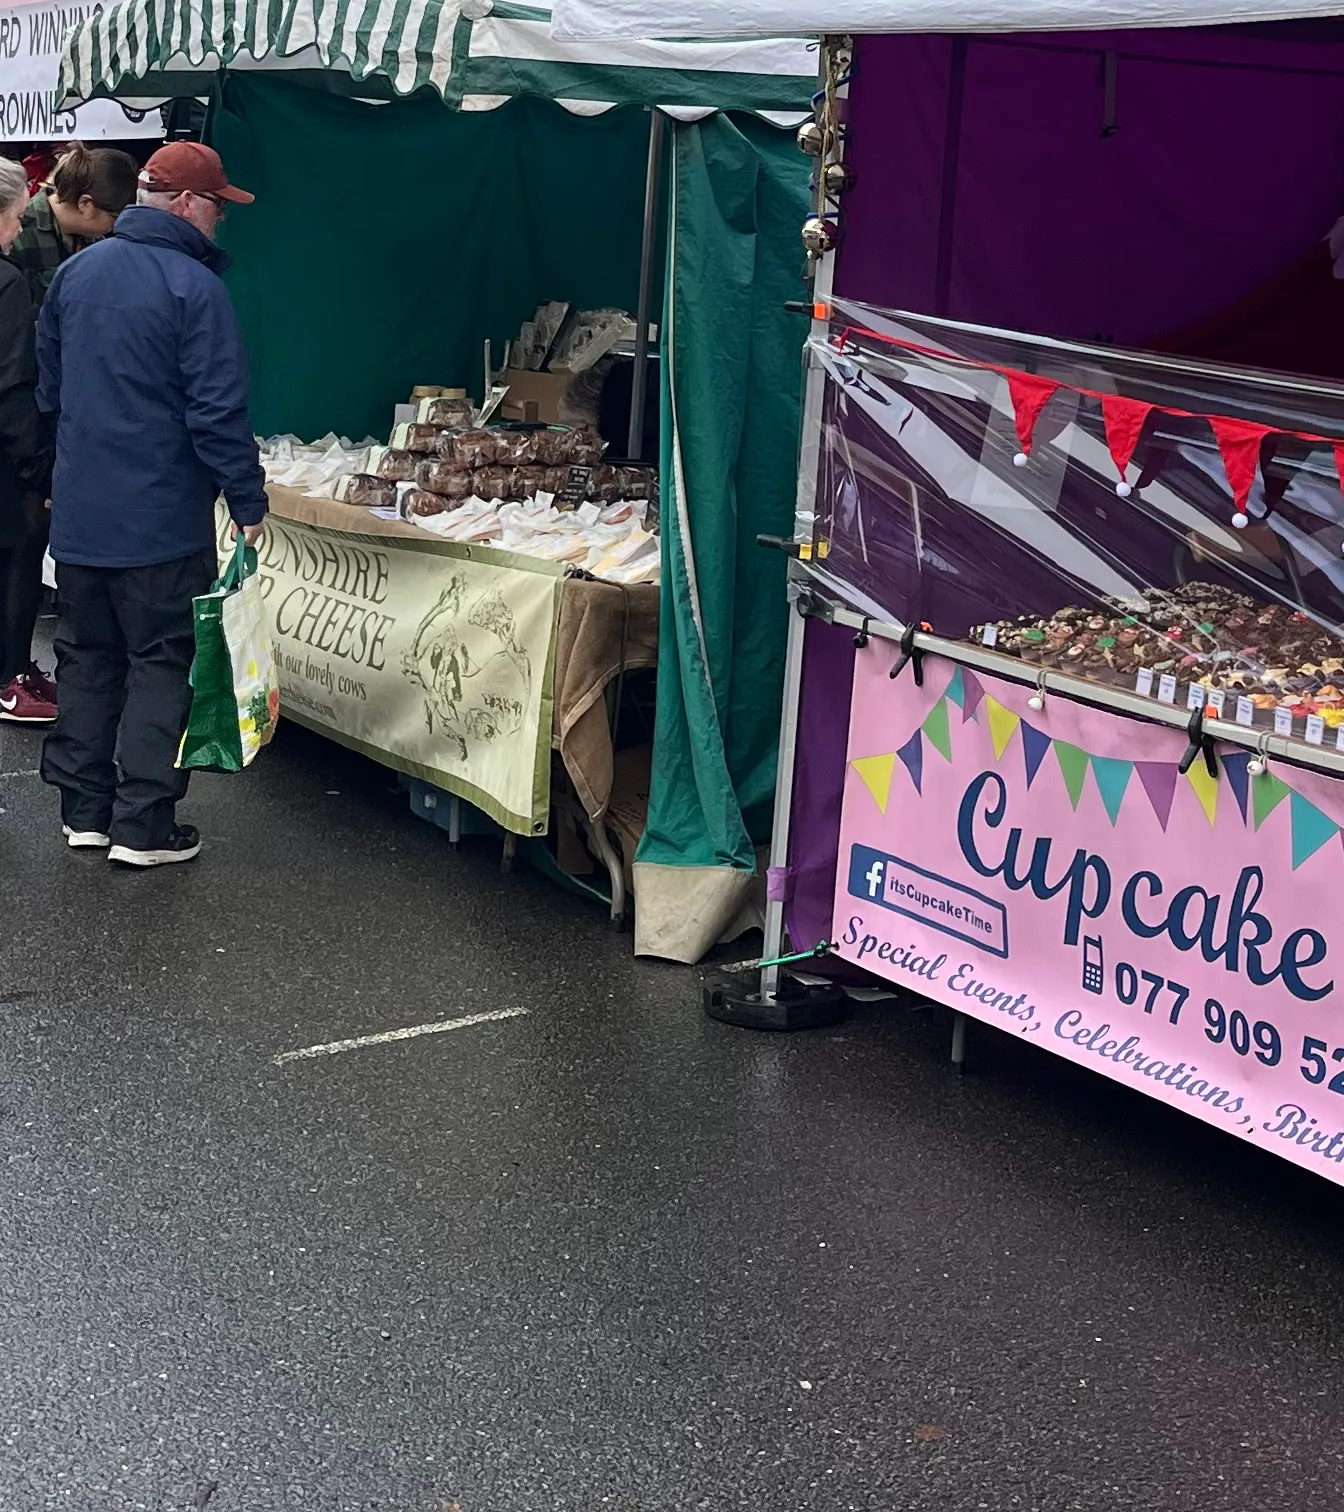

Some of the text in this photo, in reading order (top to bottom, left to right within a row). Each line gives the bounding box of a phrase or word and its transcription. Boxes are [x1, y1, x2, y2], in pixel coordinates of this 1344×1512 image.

[29, 3, 104, 56] WINN
[272, 641, 366, 700] ith our lovely cows
[276, 587, 396, 671] CHEESE
[890, 877, 992, 933] itsCupcakeTime
[957, 770, 1334, 1002] Cupcake
[843, 916, 947, 980] Special
[947, 963, 1041, 1031] Events,
[1054, 1009, 1251, 1125] Celebrations,
[1115, 961, 1190, 1025] 077
[1205, 998, 1282, 1067] 909
